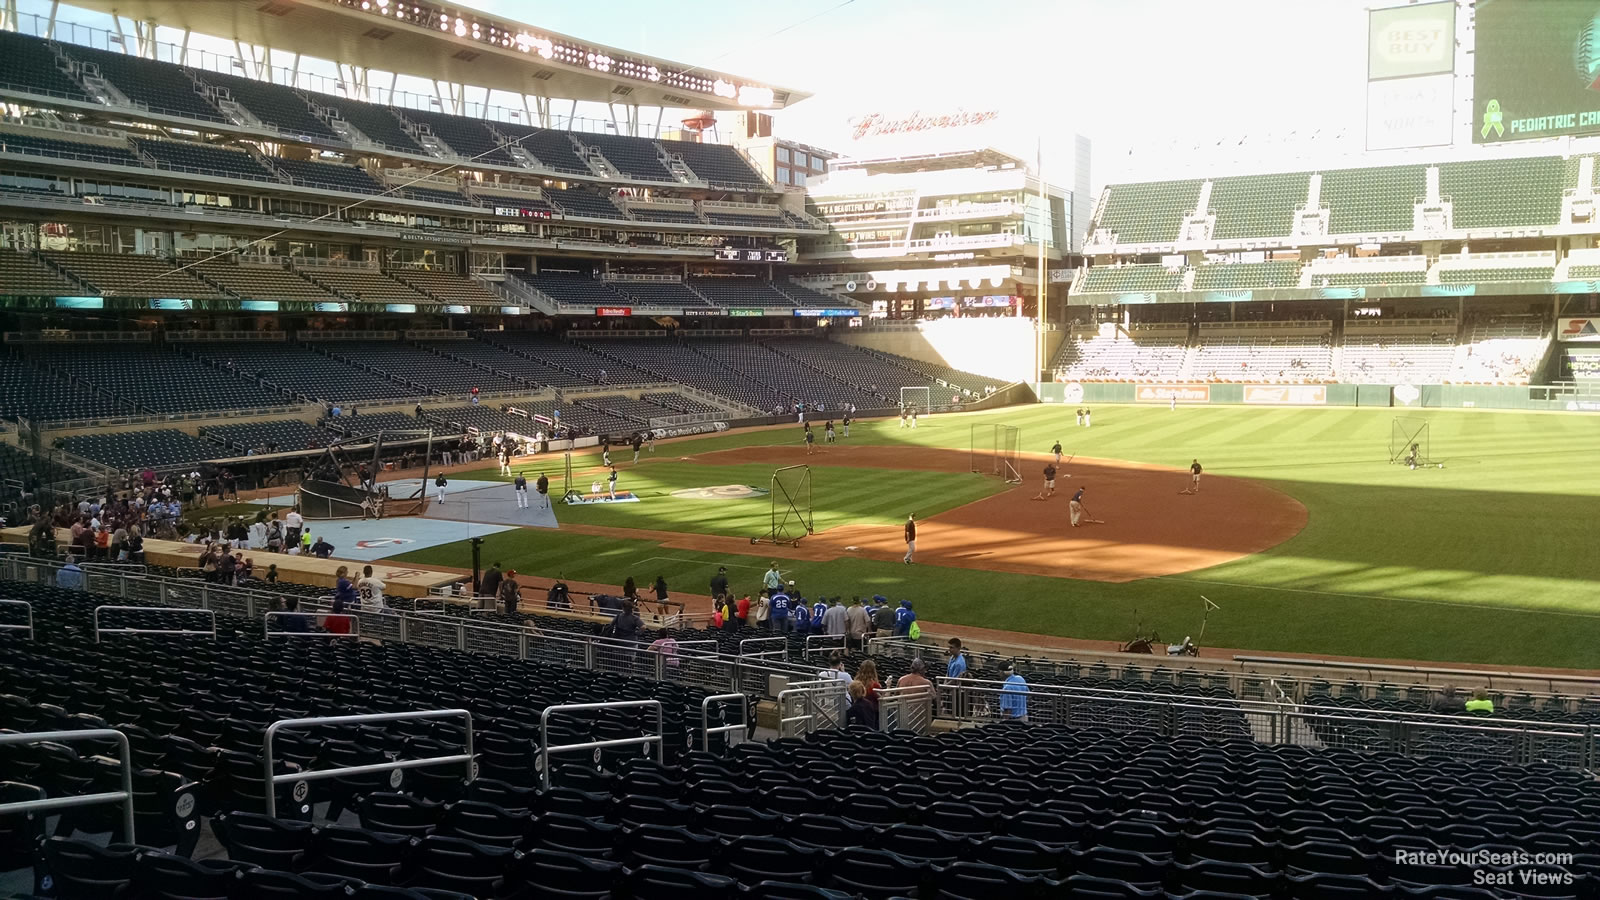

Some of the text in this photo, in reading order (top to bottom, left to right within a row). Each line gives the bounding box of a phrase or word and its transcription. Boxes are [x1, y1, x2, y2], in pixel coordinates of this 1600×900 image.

[1387, 29, 1442, 41] BEST
[1389, 43, 1435, 54] BUY
[848, 107, 999, 140] Budweiser
[1511, 113, 1576, 134] PEDIATRIC
[834, 203, 864, 213] BEAUTIFUL
[856, 231, 876, 240] TWINS
[668, 429, 677, 437] Go
[692, 426, 700, 434] Go
[360, 588, 373, 599] 33
[776, 600, 787, 609] 25
[814, 608, 823, 617] 11
